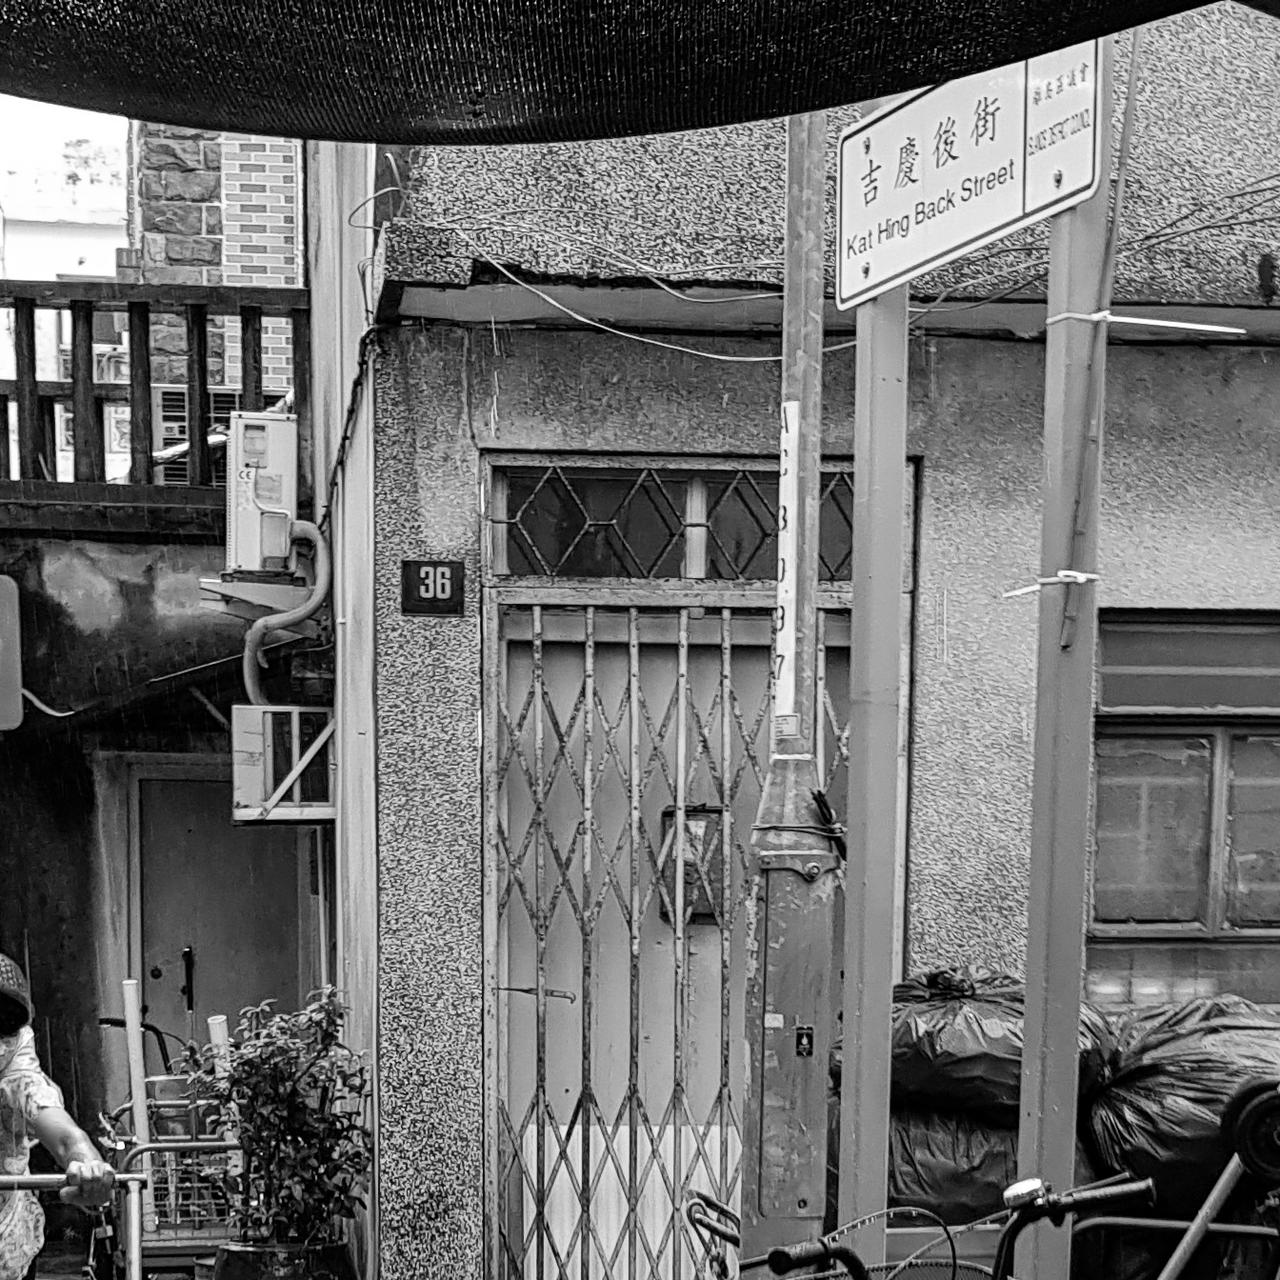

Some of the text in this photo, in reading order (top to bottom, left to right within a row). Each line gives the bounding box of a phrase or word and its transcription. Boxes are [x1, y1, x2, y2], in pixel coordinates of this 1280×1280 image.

[861, 96, 1001, 207] 吉慶後街
[846, 158, 1015, 259] Kat Hing Back Street
[419, 566, 451, 600] 36
